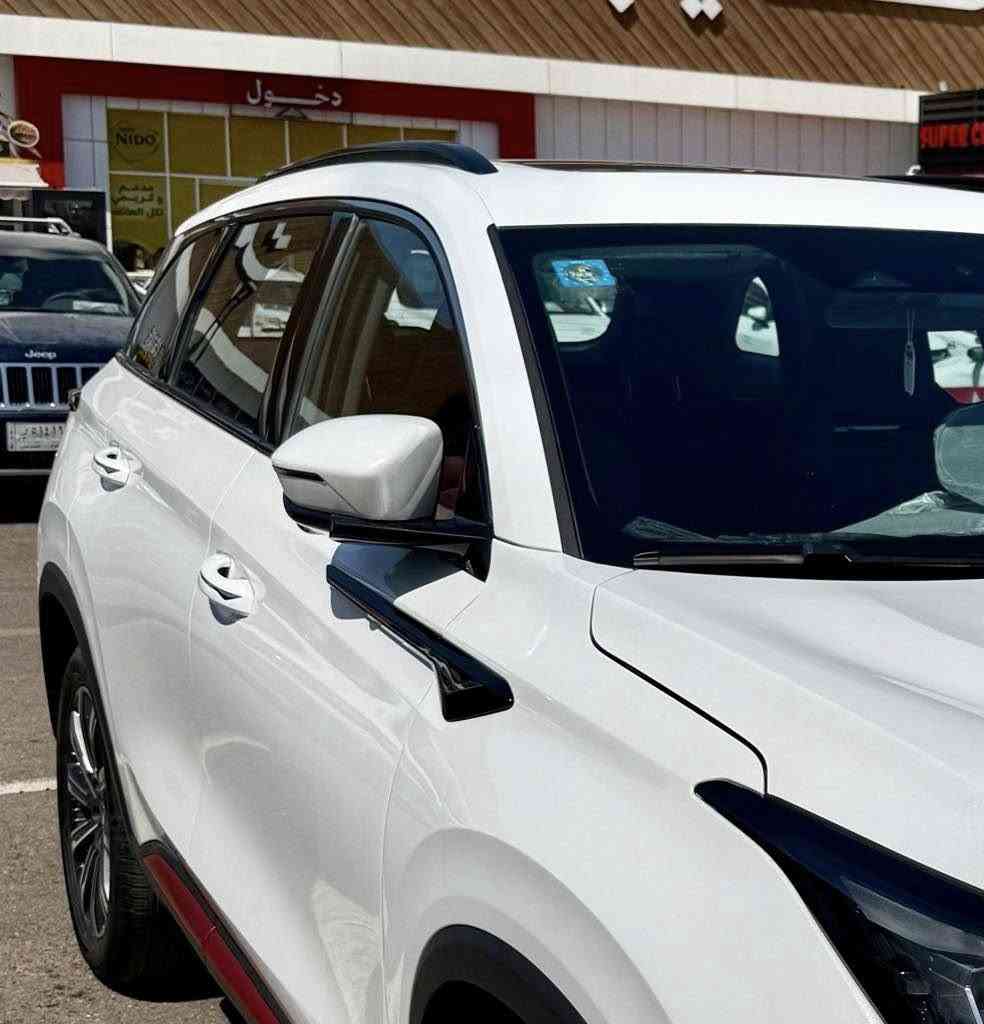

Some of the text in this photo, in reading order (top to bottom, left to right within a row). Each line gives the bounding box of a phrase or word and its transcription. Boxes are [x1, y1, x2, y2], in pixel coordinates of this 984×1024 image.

[246, 79, 343, 112] دخول
[116, 131, 157, 146] NIDO
[24, 350, 57, 360] Jeep
